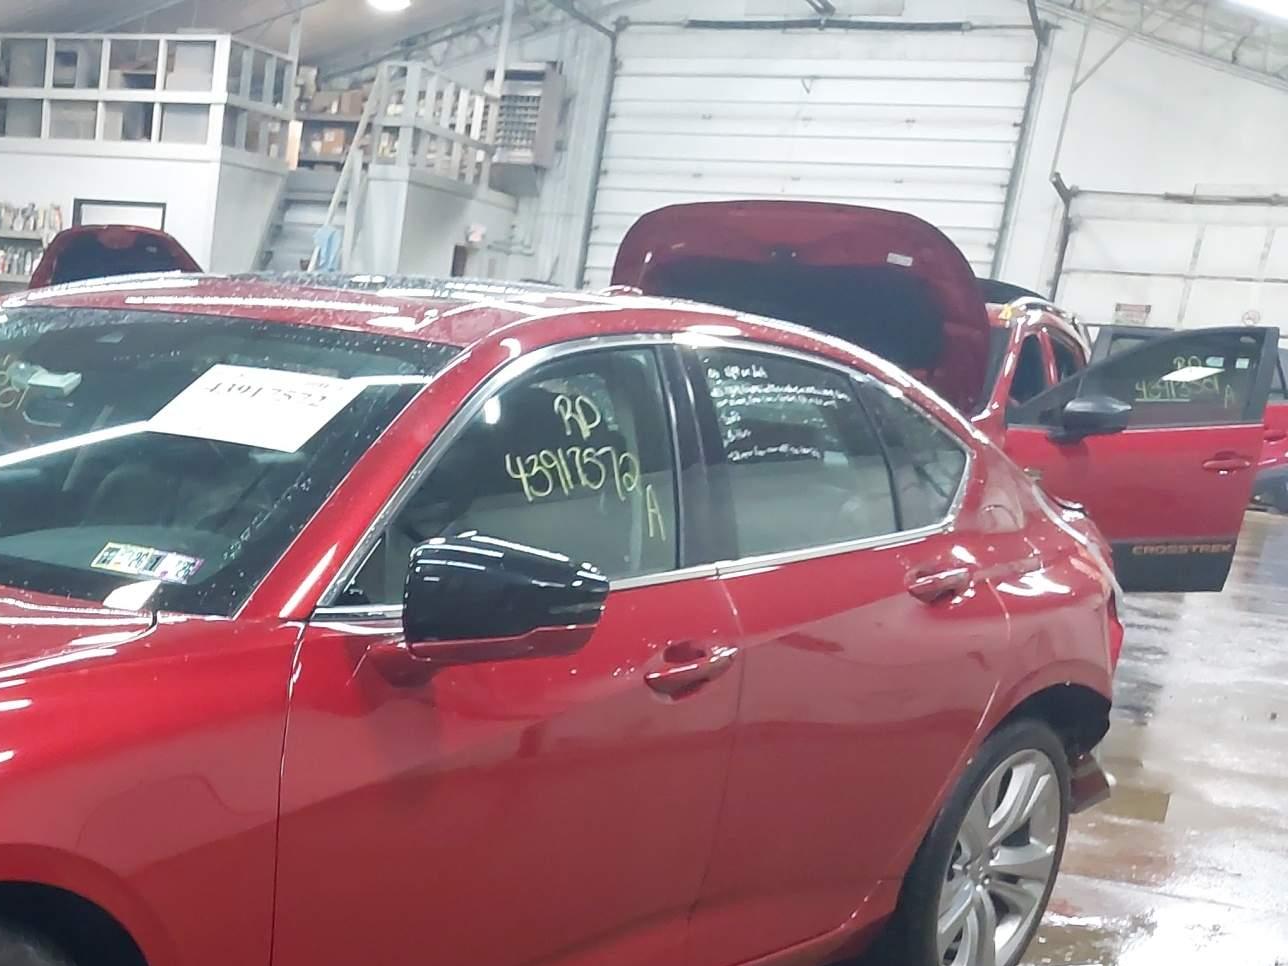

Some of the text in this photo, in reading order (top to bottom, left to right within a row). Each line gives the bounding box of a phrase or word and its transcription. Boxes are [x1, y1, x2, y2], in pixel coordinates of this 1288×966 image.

[554, 394, 601, 440] RD
[504, 446, 641, 502] 43917572
[646, 484, 666, 541] A
[1132, 543, 1232, 555] CROSSTREK
